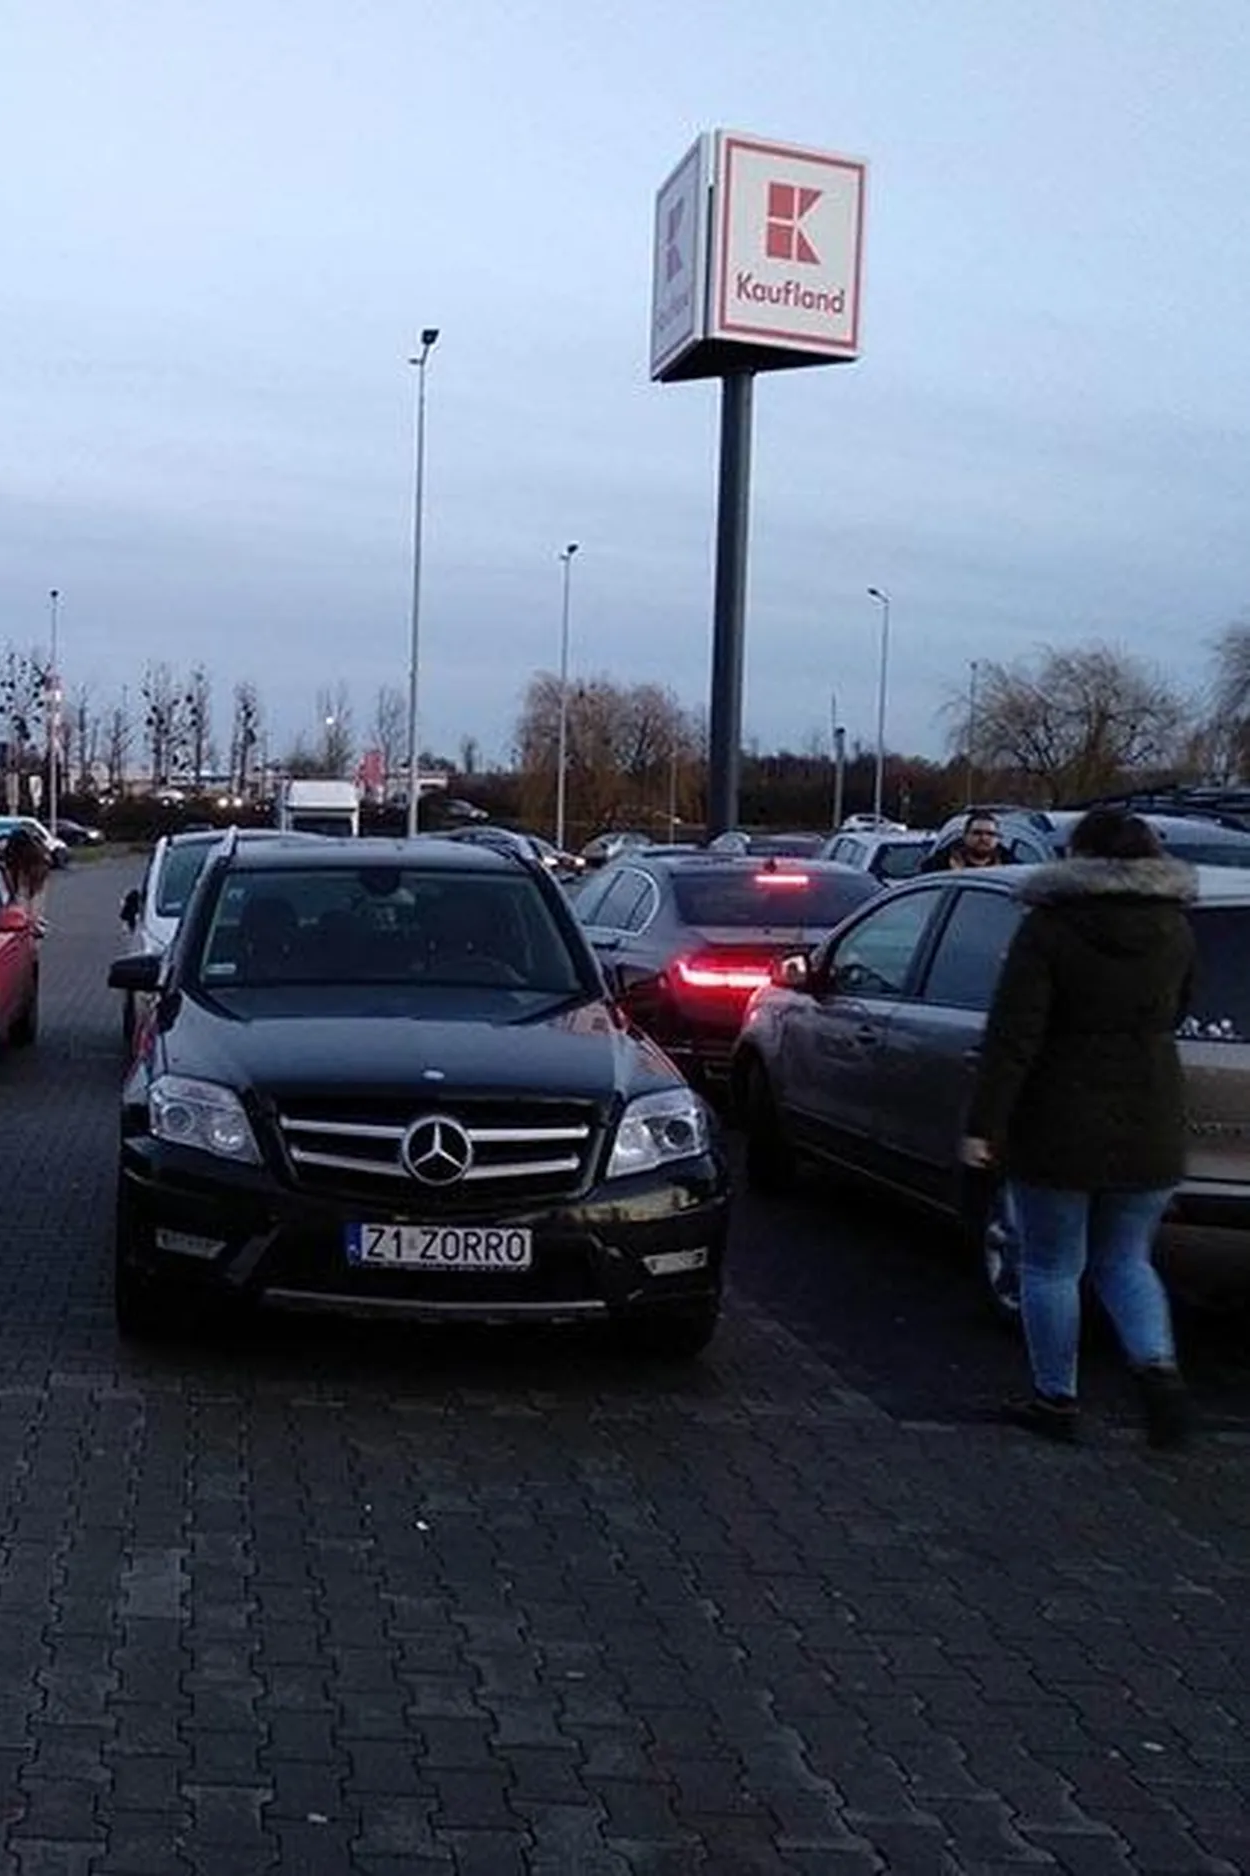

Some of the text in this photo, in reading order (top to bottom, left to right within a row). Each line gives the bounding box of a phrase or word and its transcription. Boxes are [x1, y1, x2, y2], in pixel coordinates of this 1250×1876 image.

[736, 271, 845, 314] Kaufland
[367, 1227, 526, 1263] Z1 ZORRO
